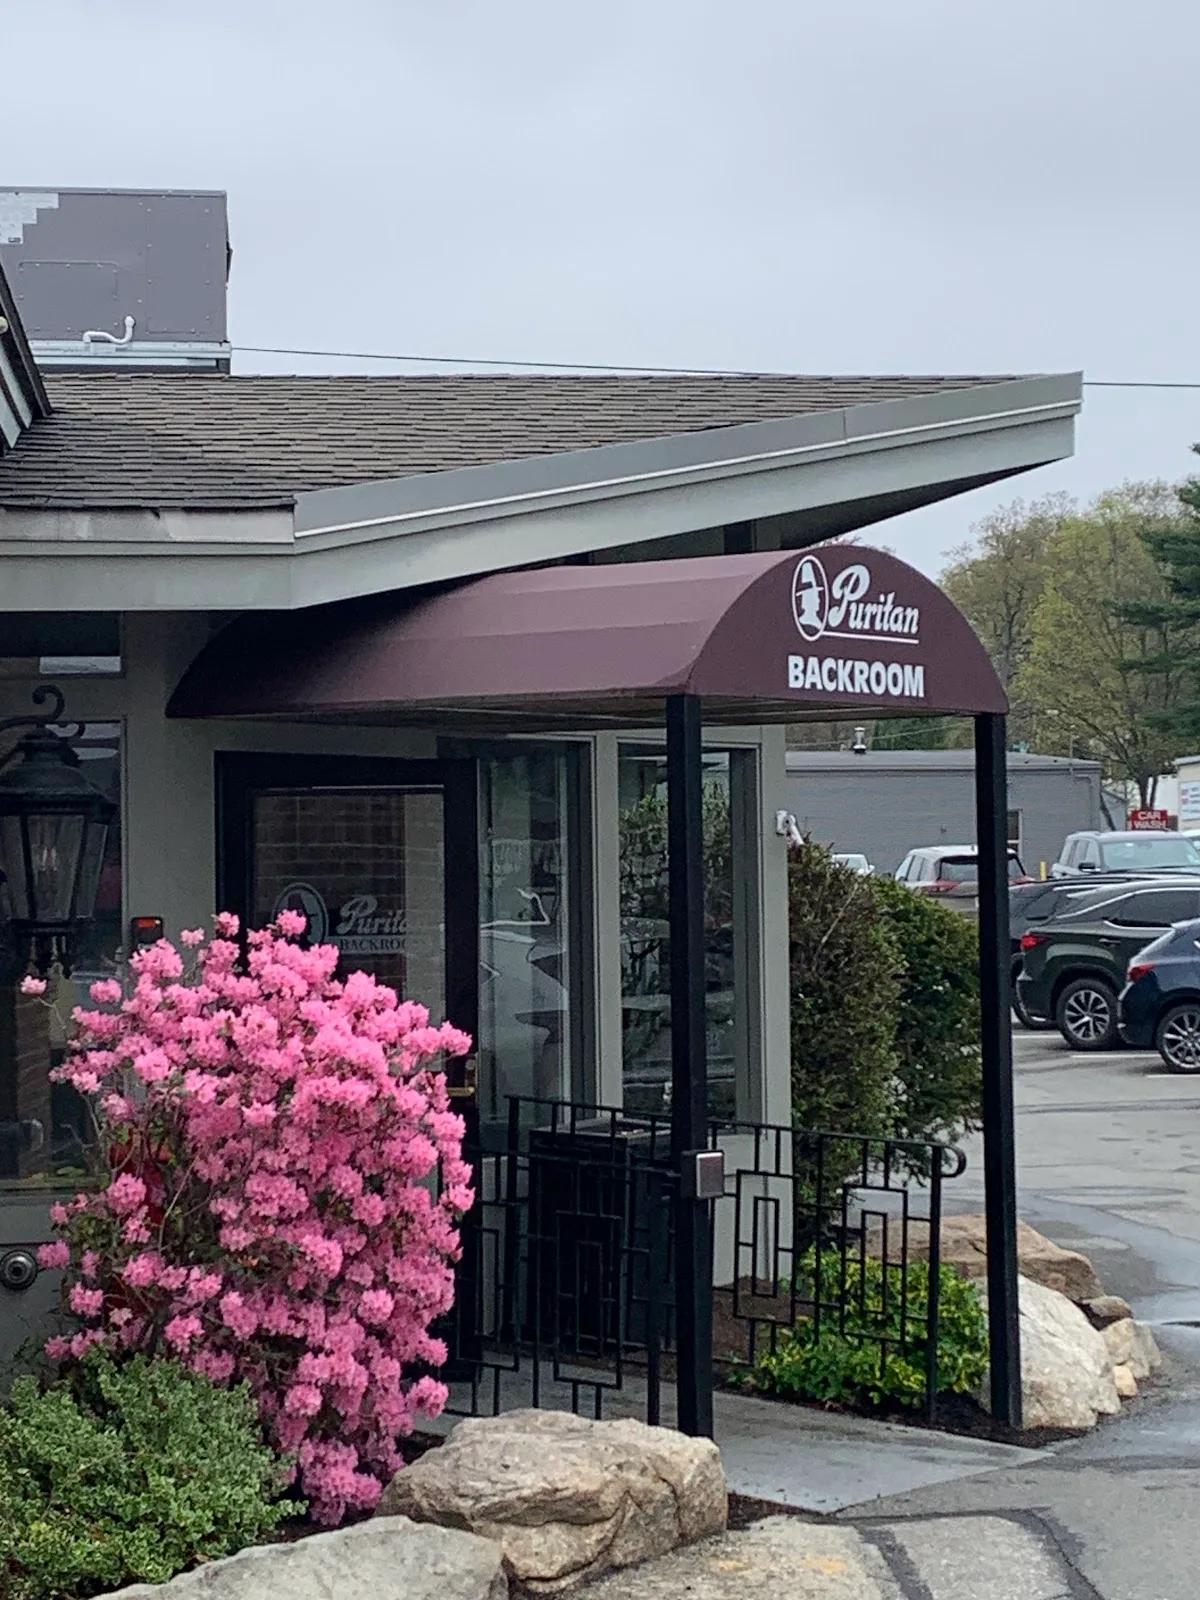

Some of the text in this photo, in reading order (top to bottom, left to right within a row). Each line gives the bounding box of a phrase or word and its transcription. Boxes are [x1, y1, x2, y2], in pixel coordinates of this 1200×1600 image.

[827, 564, 919, 634] Puritan
[788, 655, 925, 698] BACKROOM
[1134, 820, 1167, 830] WASH
[1138, 811, 1162, 820] CAR
[336, 895, 409, 934] Purita
